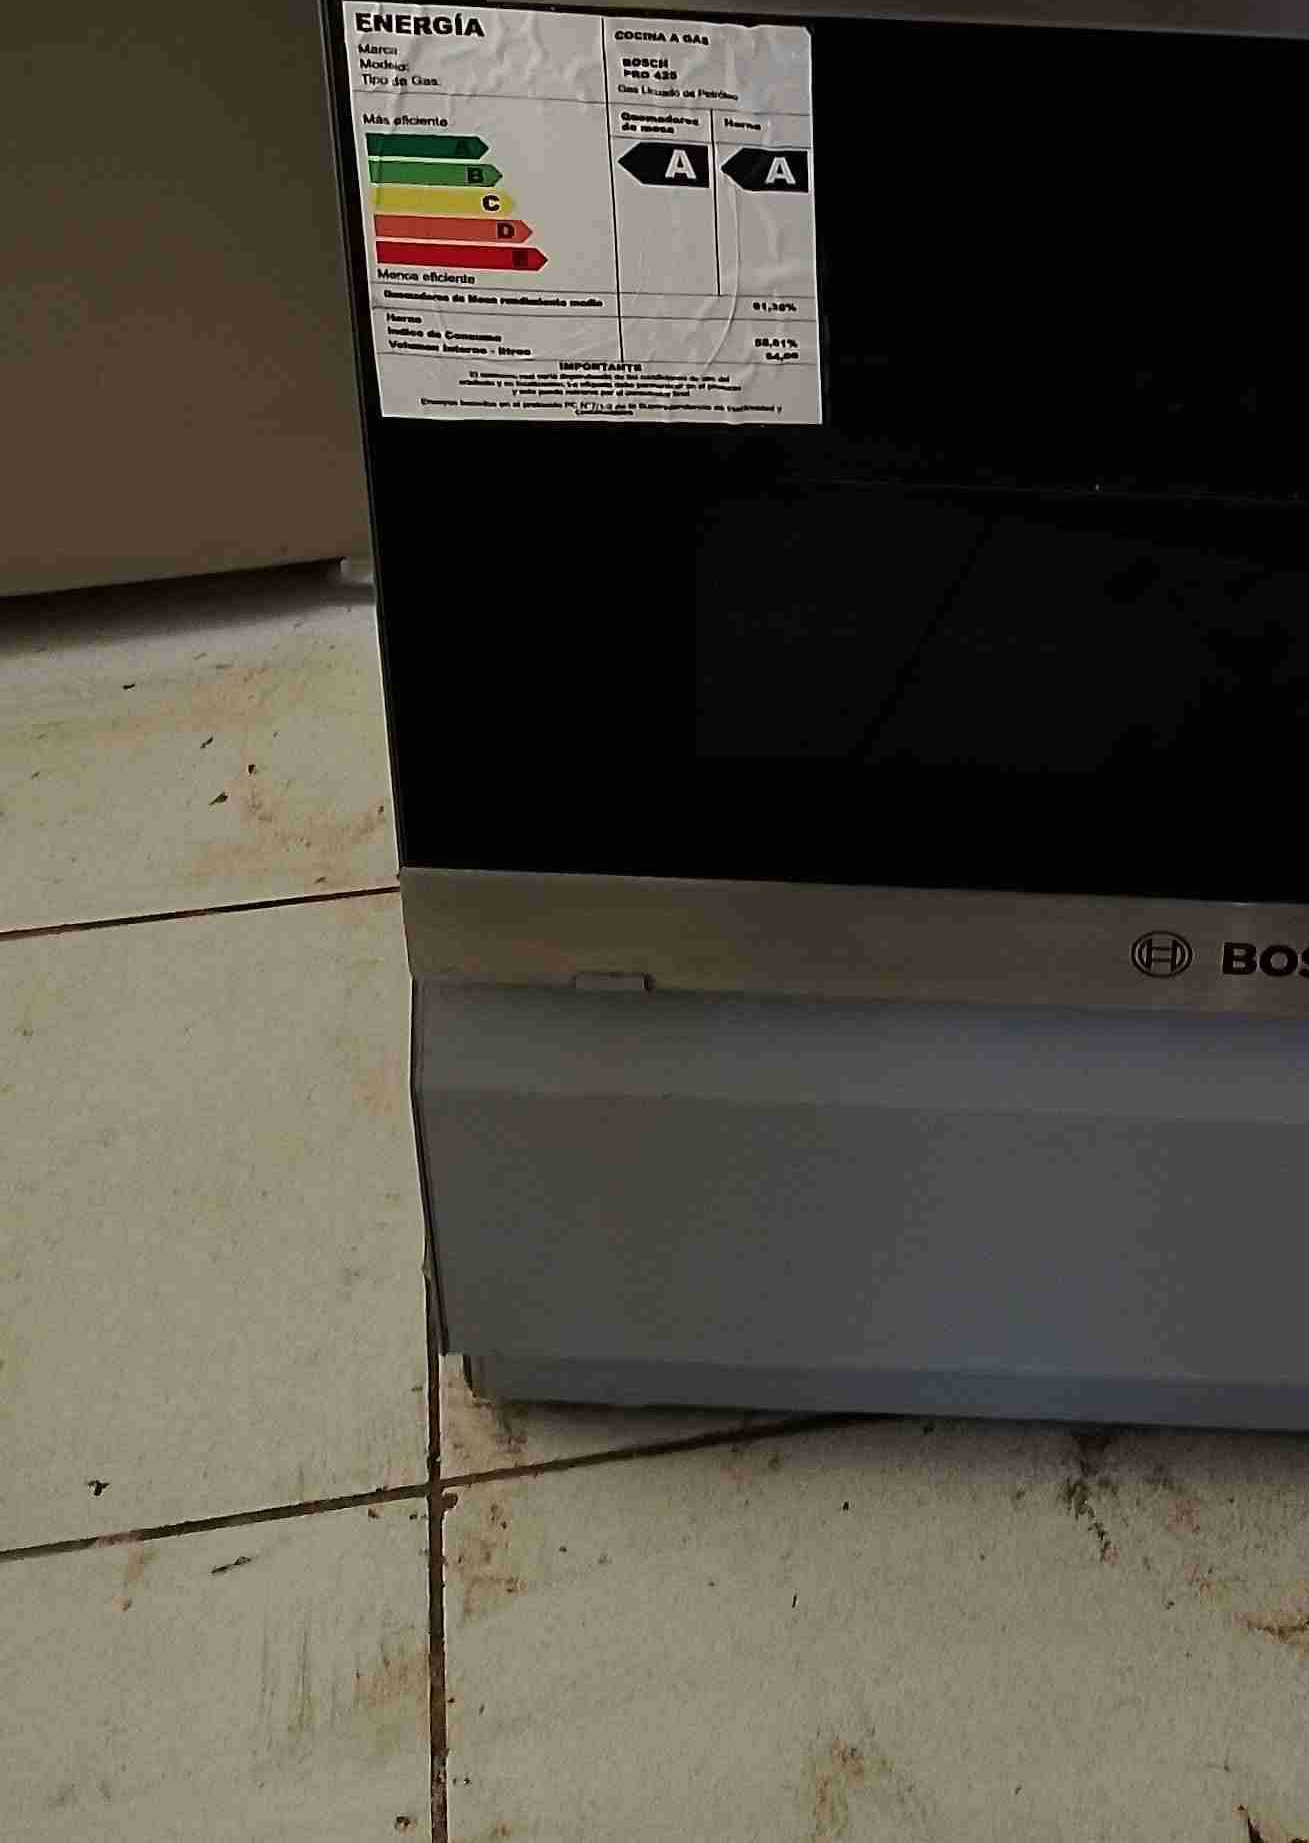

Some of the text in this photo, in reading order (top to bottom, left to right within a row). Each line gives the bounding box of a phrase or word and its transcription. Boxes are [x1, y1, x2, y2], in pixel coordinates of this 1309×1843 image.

[355, 12, 486, 37] ENERGÍA
[615, 30, 710, 46] COCINA A GAS
[622, 58, 669, 69] BOSCH
[362, 74, 389, 87] Tipo
[623, 69, 650, 80] PRO
[393, 115, 449, 128] eficiente
[724, 118, 762, 131] Horno
[664, 148, 697, 180] A
[764, 156, 797, 185] A
[467, 167, 484, 183] B
[481, 194, 501, 212] C
[496, 222, 516, 239] D
[422, 271, 476, 285] eficiente
[559, 362, 643, 373] IMPORTANTE
